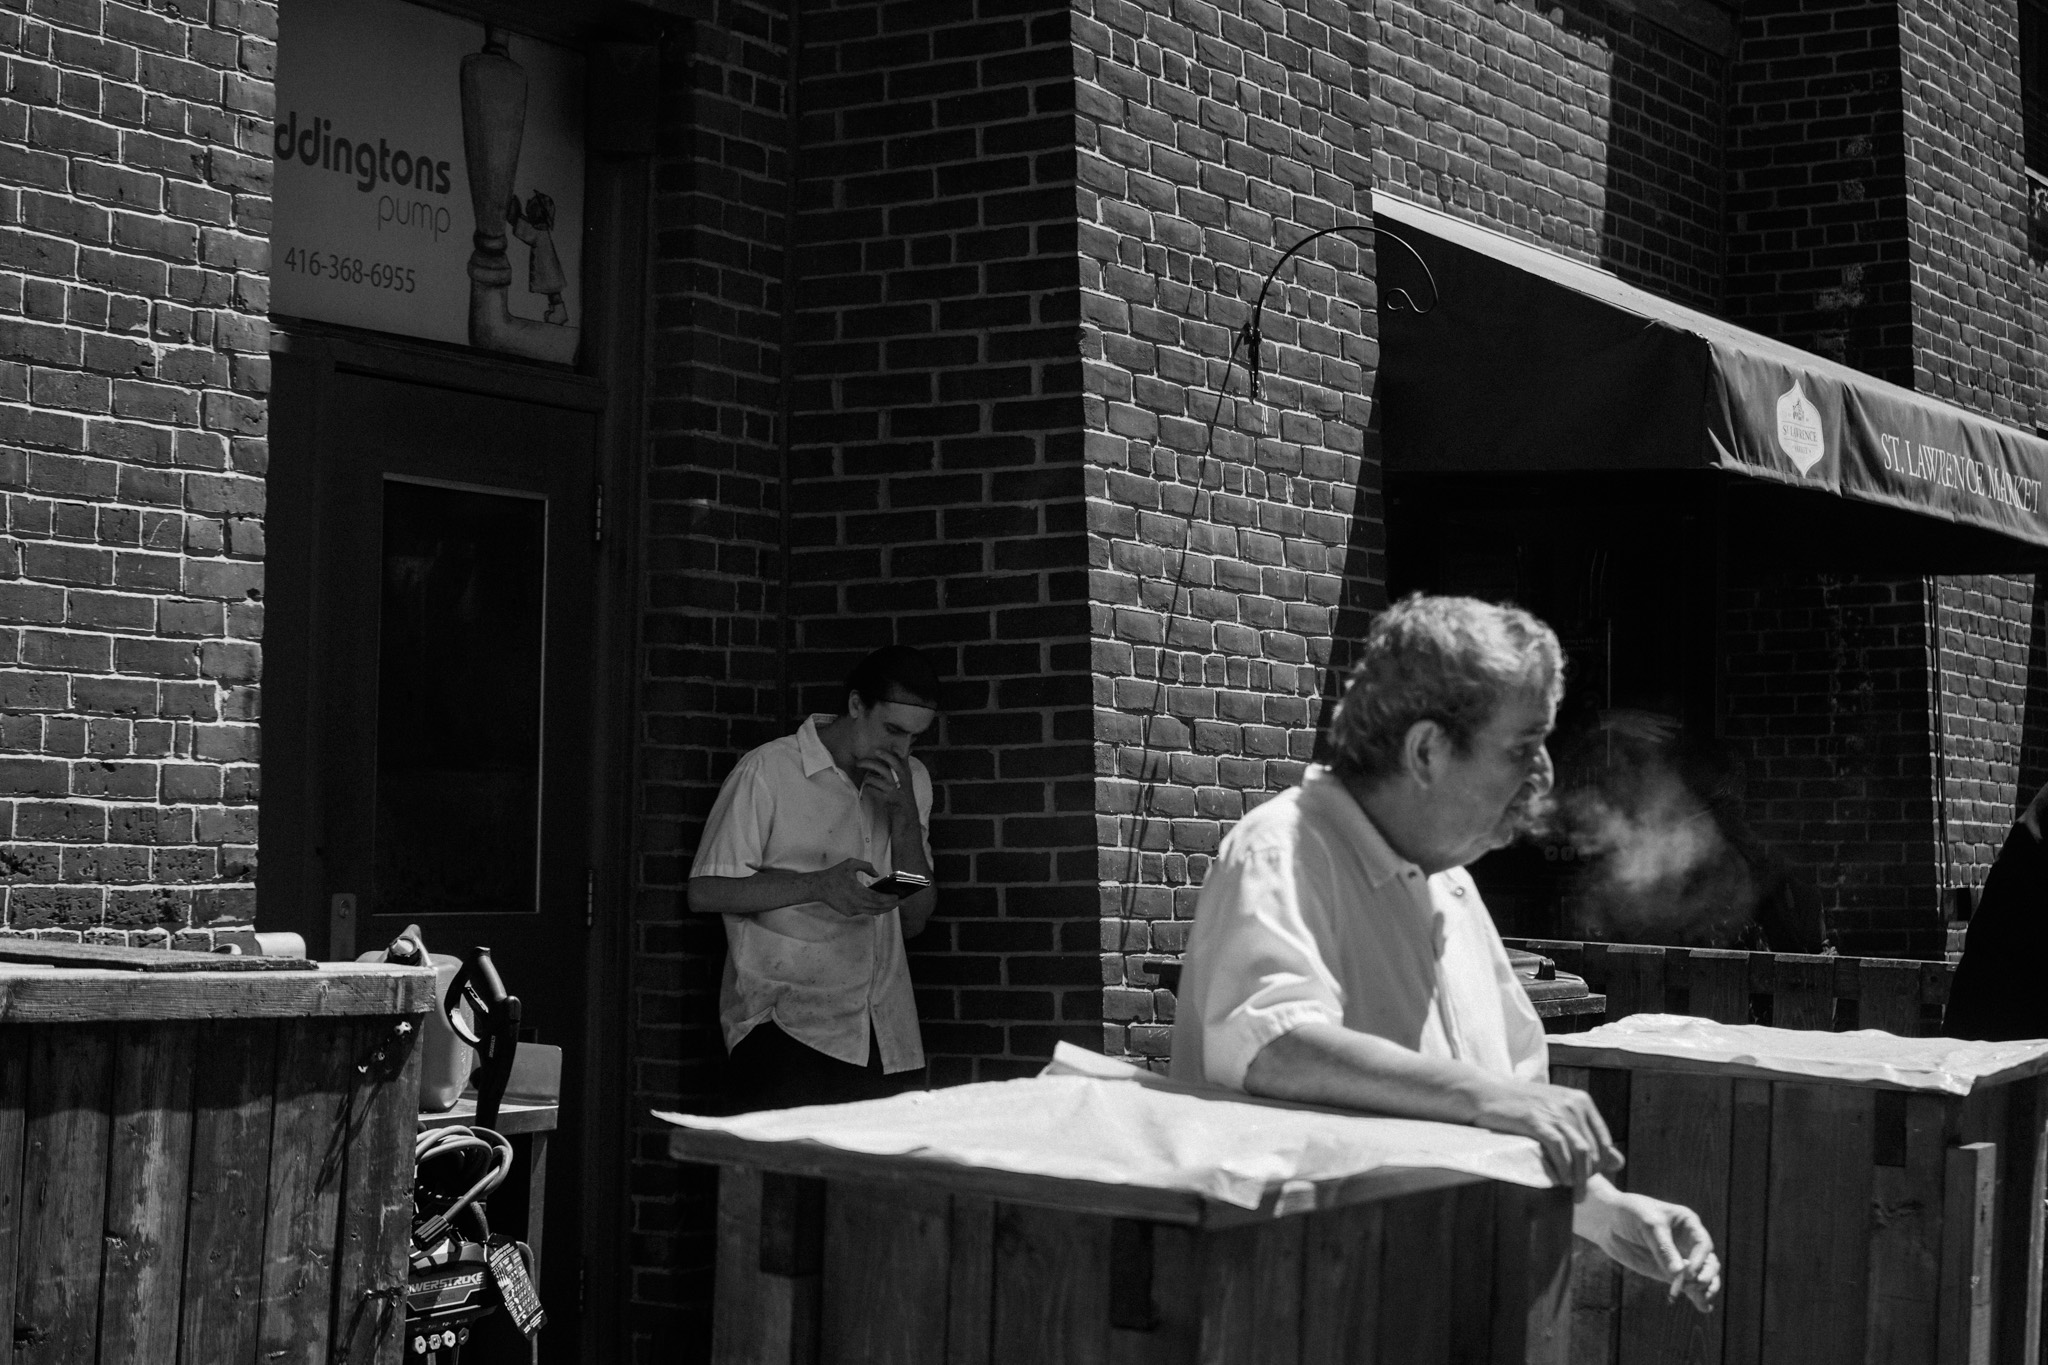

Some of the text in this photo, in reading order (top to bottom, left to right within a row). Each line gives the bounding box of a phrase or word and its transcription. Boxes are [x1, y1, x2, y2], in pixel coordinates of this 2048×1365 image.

[274, 111, 450, 194] ddingtons
[378, 195, 450, 242] pump
[284, 246, 416, 294] 416-368-6955
[1881, 432, 2042, 514] ST. LAWRENCE MARKET
[408, 1271, 485, 1294] WERSTROKE
